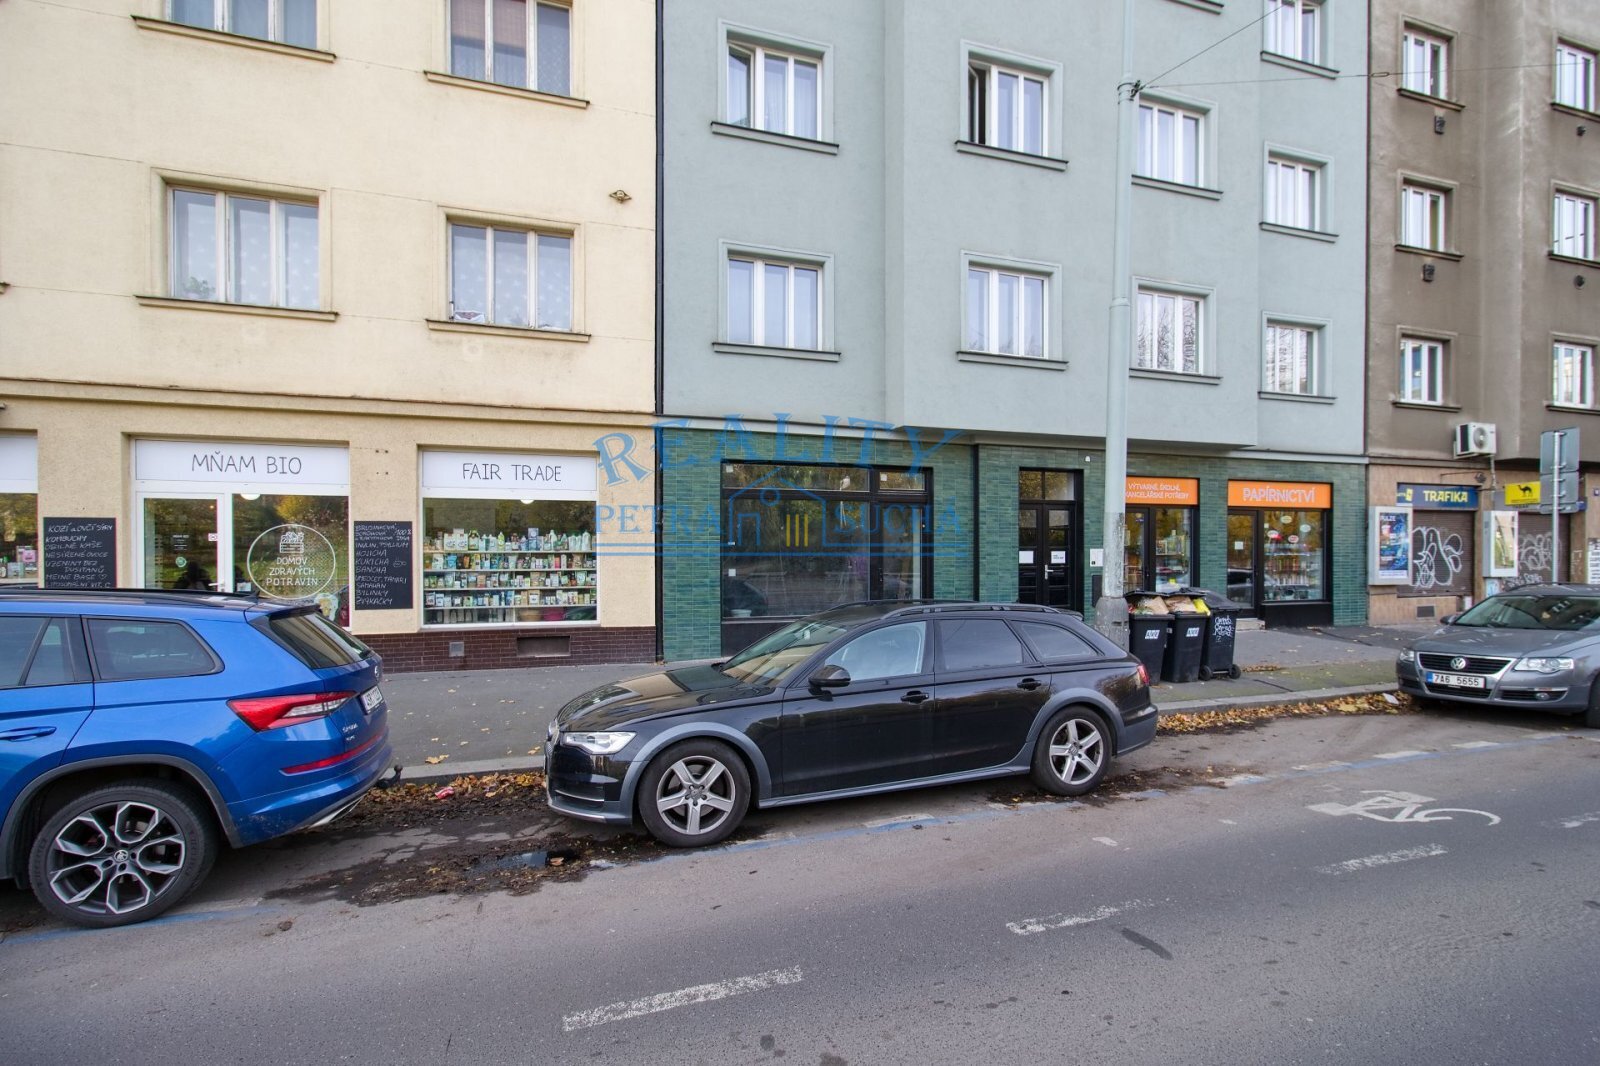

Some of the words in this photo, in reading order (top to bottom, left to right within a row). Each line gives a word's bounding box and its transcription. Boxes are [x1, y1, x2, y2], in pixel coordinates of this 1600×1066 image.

[192, 451, 256, 473] MŇAM
[266, 456, 302, 475] BIO
[462, 463, 502, 480] FAIR
[511, 464, 562, 482] TRADE
[1243, 486, 1316, 503] PAPÍRNICTVÍ
[1423, 490, 1468, 503] TRAFIKA
[276, 557, 308, 566] DOMOV
[269, 565, 316, 576] ZDRAVÝCH
[266, 577, 318, 586] POTRAVIN
[1434, 674, 1451, 684] 7A6
[1456, 676, 1479, 687] 5655
